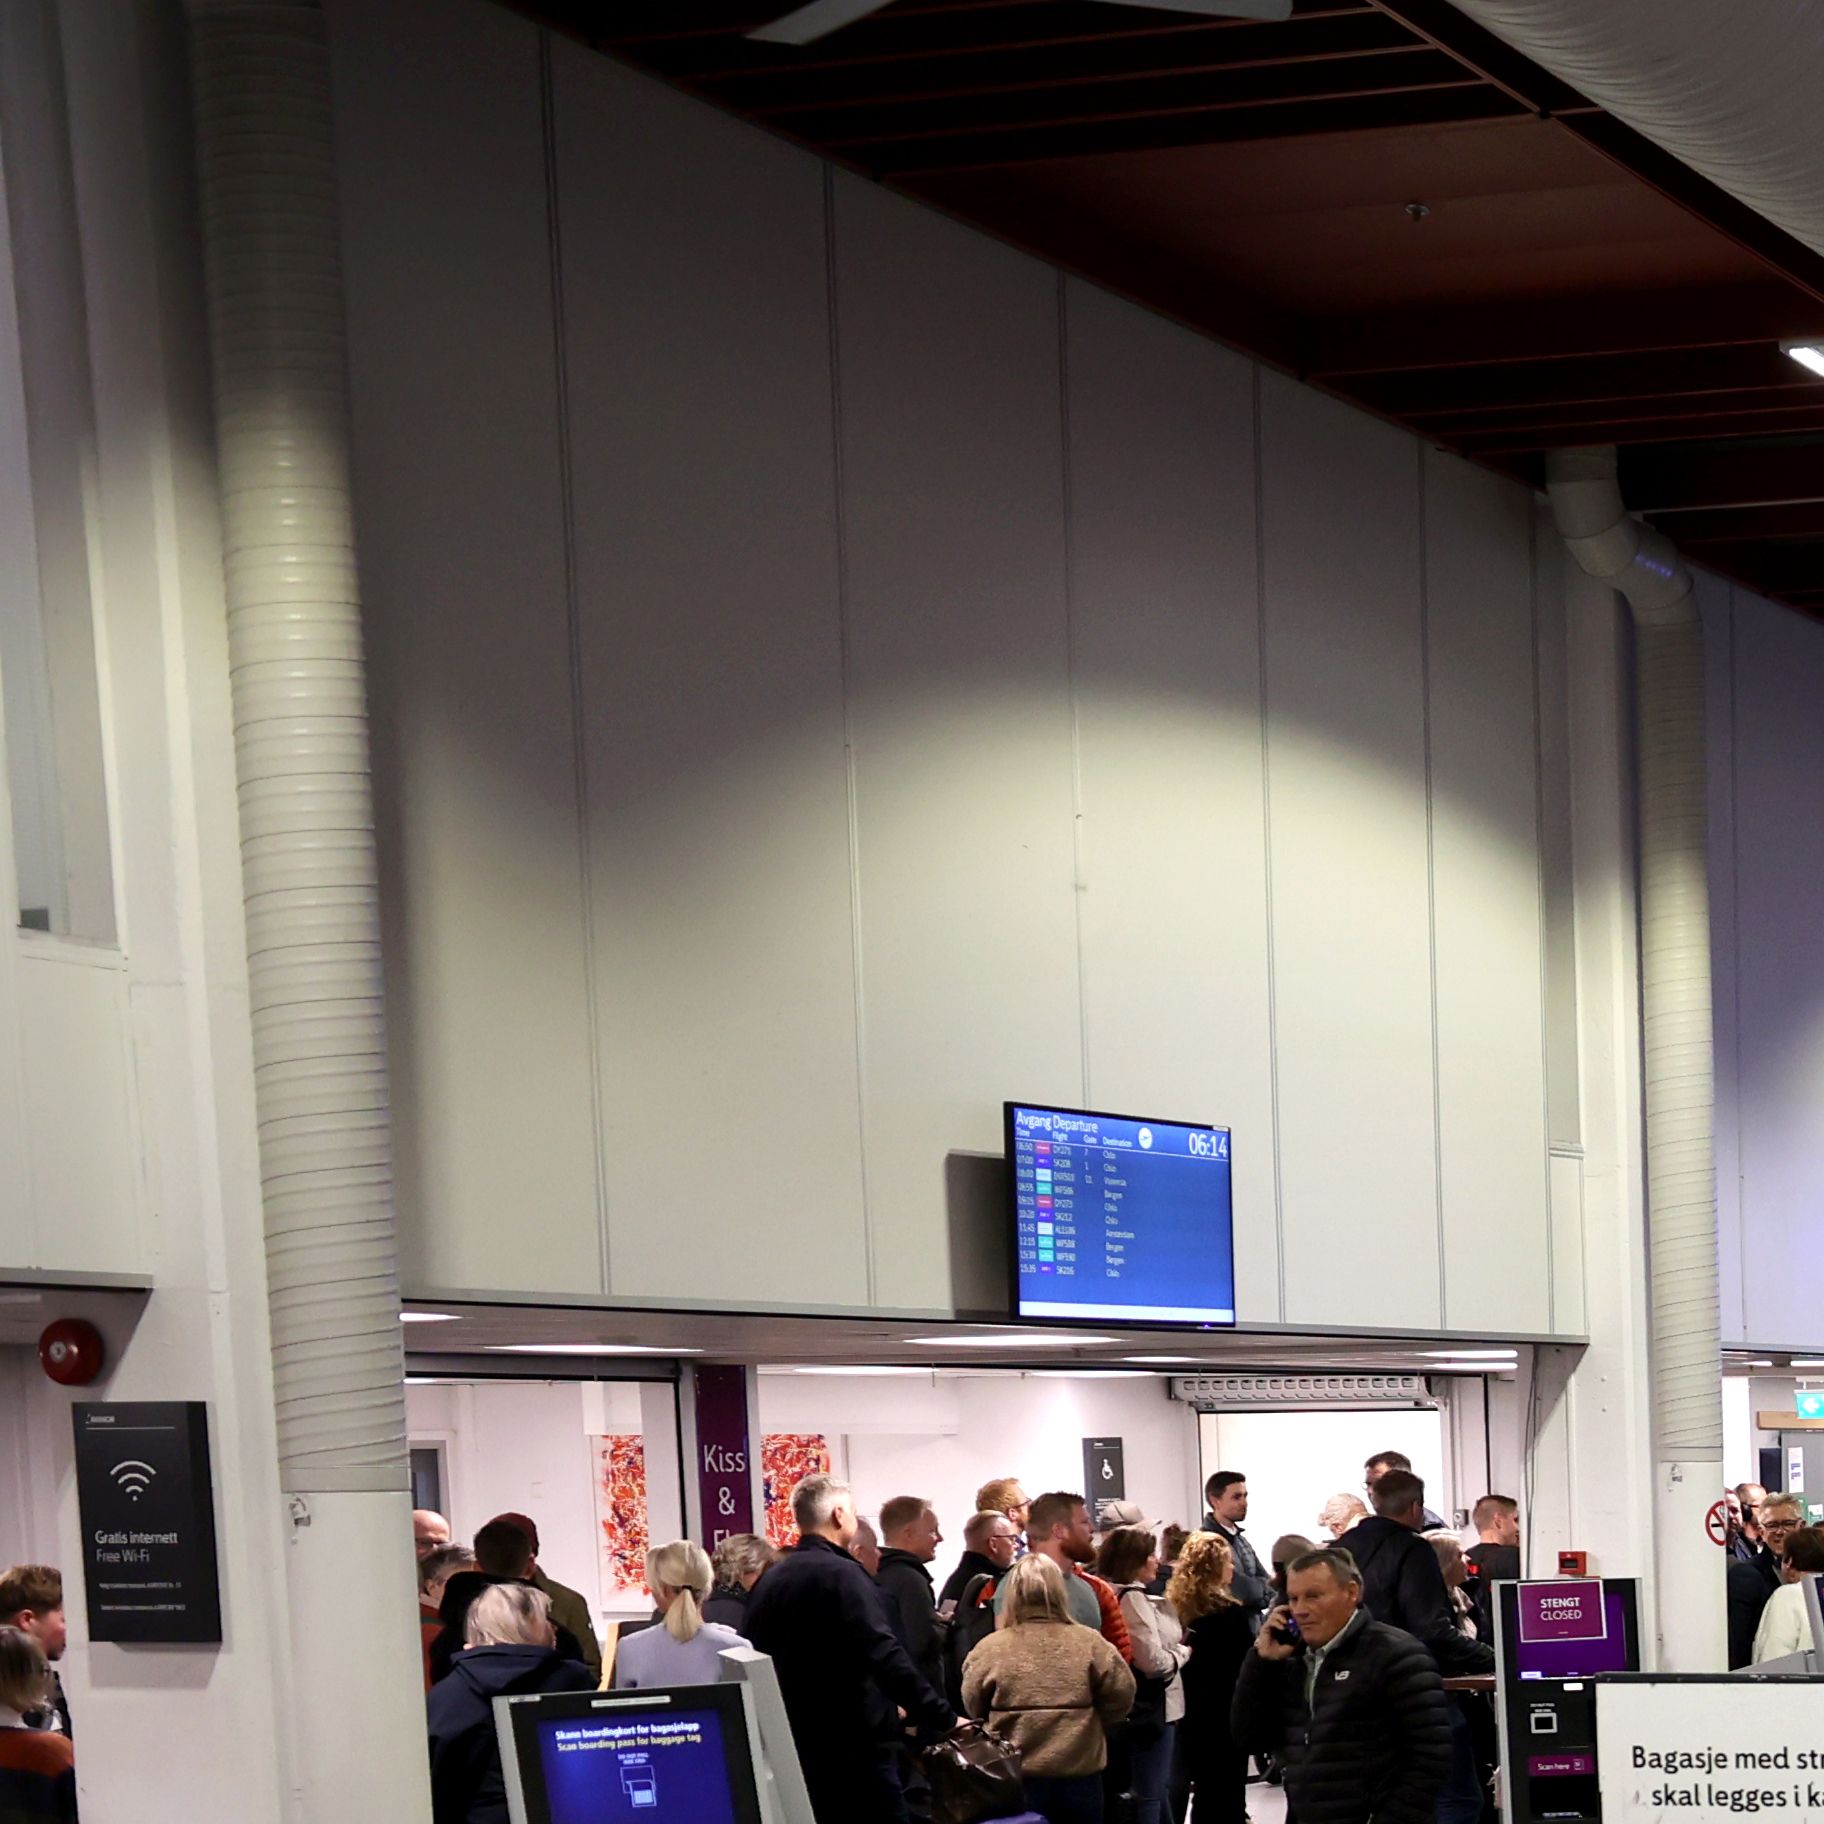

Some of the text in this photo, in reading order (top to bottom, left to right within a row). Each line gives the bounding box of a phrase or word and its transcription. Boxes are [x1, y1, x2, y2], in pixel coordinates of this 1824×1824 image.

[1016, 1111, 1098, 1133] Avgang Departure
[1189, 1132, 1227, 1157] 06:14
[703, 1444, 746, 1472] Kiss
[718, 1486, 735, 1515] &
[95, 1530, 178, 1544] Gratis internett
[96, 1549, 150, 1562] Free Wi-Fi
[1540, 1597, 1580, 1608] STENGT
[1541, 1610, 1582, 1620] CLOSED
[637, 1725, 649, 1734] for
[557, 1742, 577, 1751] Scan
[578, 1740, 616, 1750] boarding
[617, 1739, 635, 1748] pass
[651, 1735, 686, 1745] baggage
[687, 1734, 701, 1743] tag
[1632, 1746, 1728, 1774] Bagasje
[1735, 1747, 1789, 1769] med
[1652, 1784, 1700, 1807] skal
[1708, 1784, 1787, 1812] legges
[1794, 1785, 1801, 1807] i
